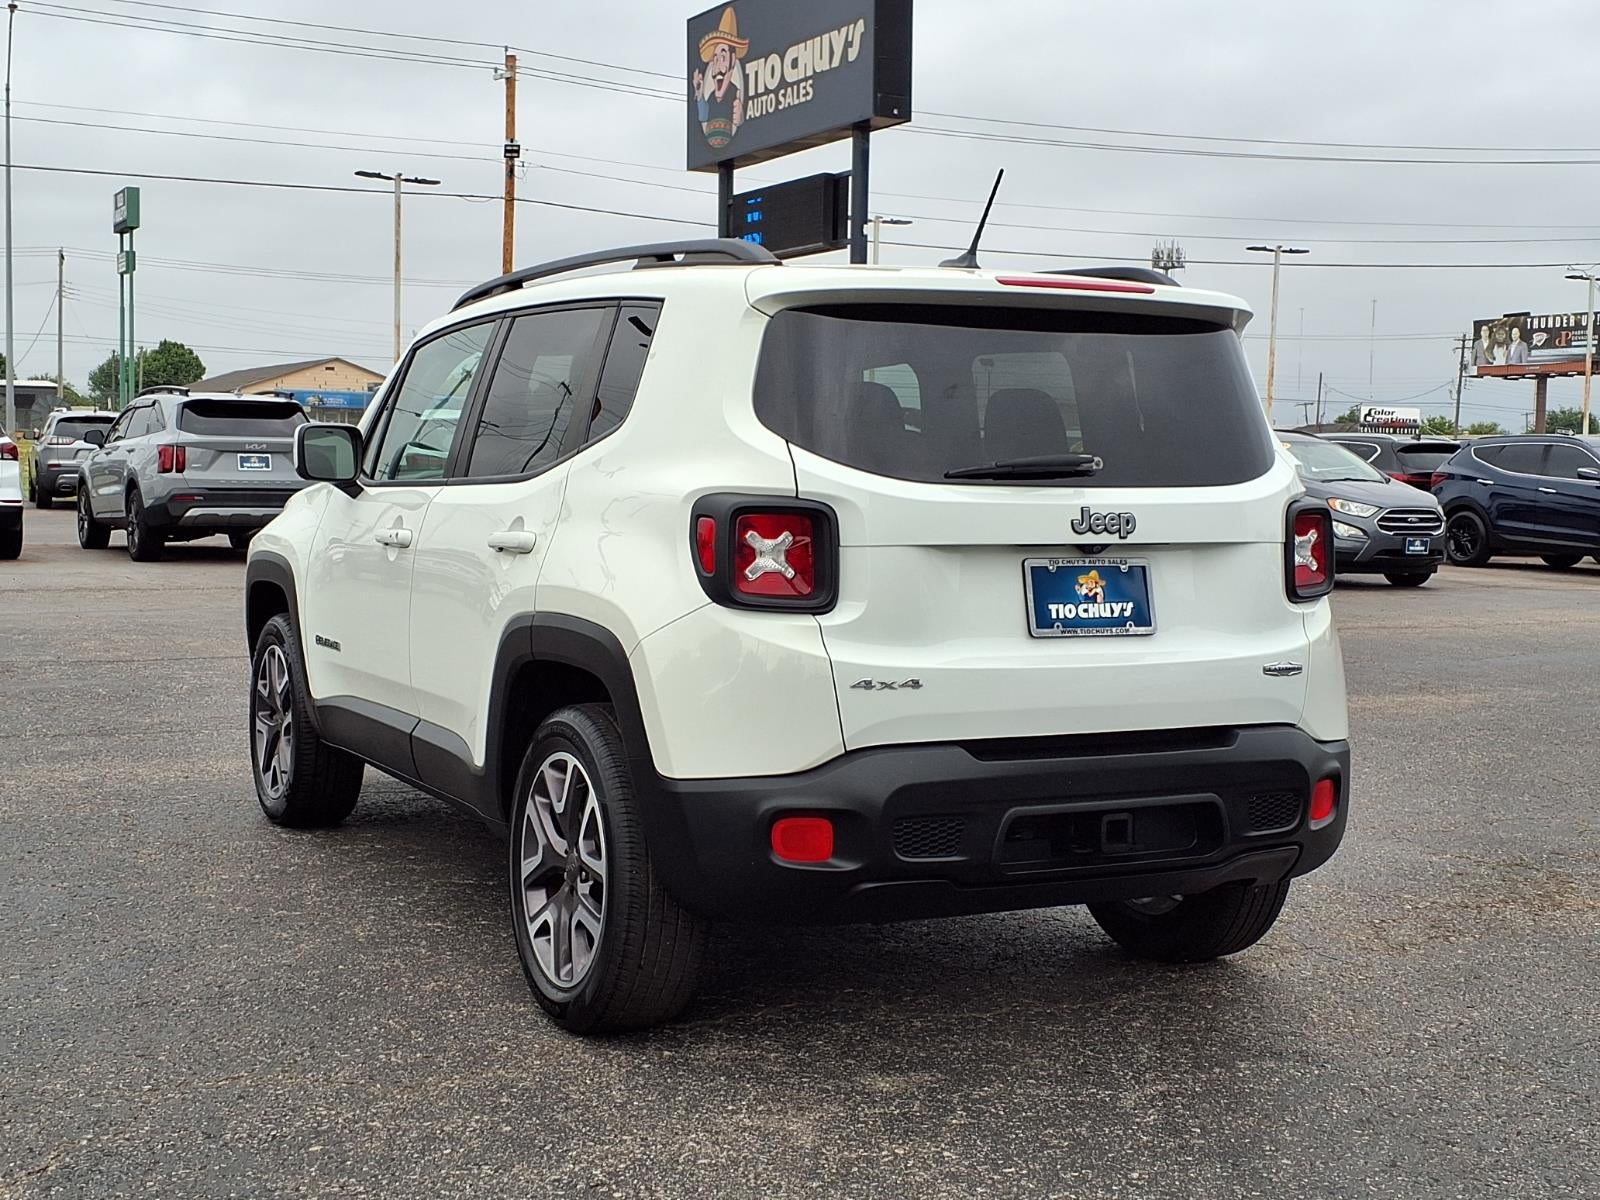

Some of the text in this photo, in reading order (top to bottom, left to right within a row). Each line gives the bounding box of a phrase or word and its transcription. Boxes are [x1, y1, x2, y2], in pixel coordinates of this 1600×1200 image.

[745, 18, 865, 96] TIO CHUY'S
[746, 80, 814, 120] AUTO SALES
[1527, 313, 1600, 329] THUNDER U!
[1363, 414, 1418, 424] Creations
[1368, 407, 1396, 417] Color
[1071, 506, 1136, 539] Jeep
[1048, 602, 1134, 619] TIO CHUY'S
[849, 677, 923, 690] 4x4
